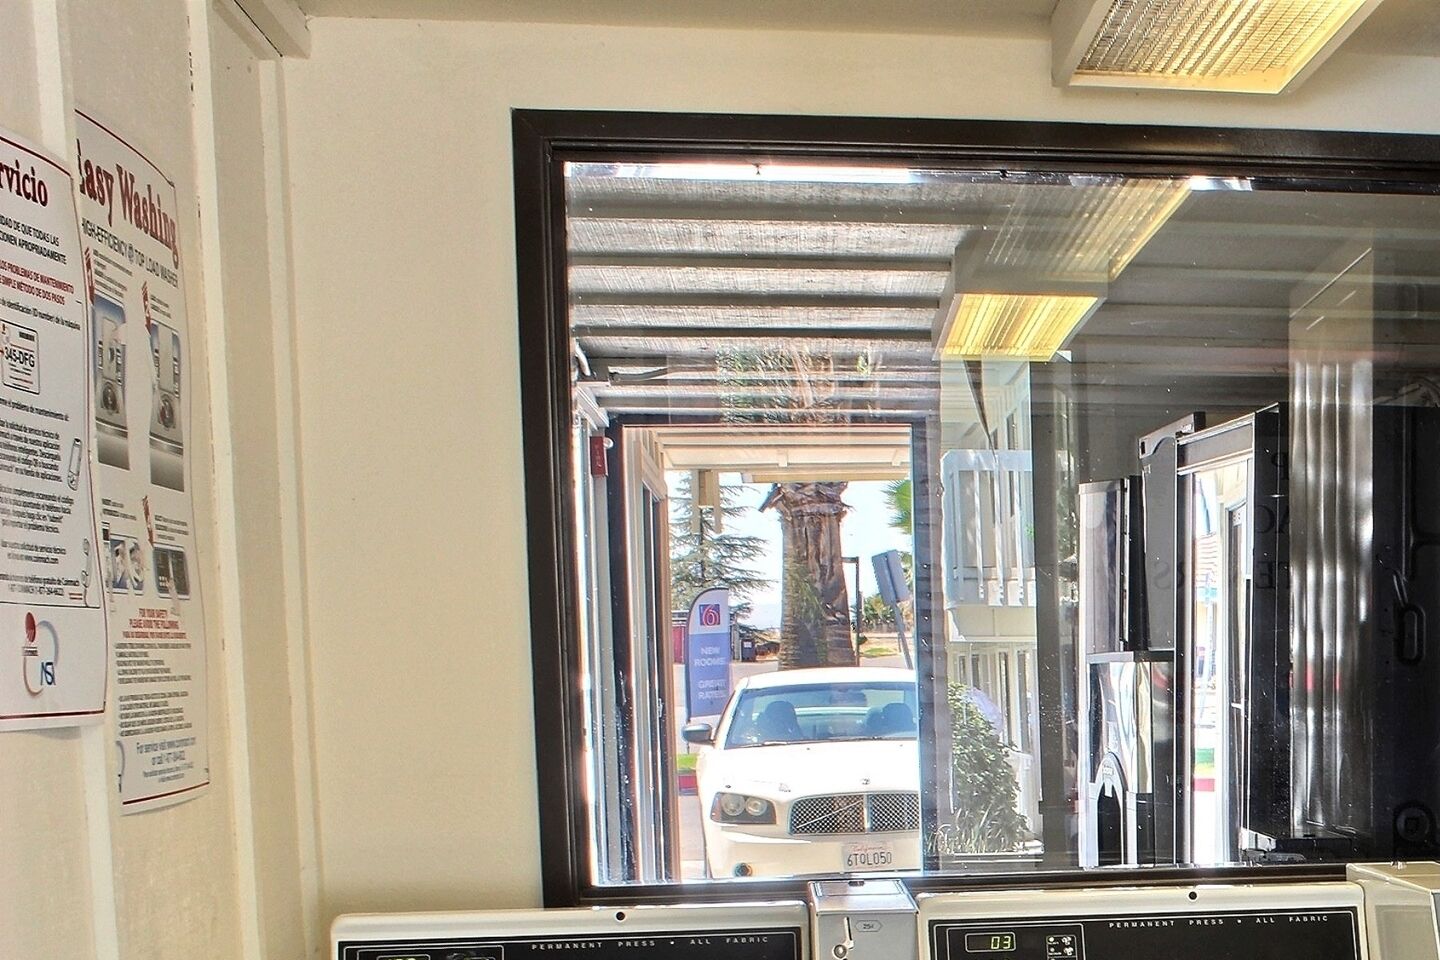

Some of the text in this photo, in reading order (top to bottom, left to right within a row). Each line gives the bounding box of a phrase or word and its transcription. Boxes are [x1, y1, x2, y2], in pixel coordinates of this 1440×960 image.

[116, 163, 179, 269] Washing
[700, 646, 720, 655] NEW
[1109, 920, 1175, 928] PERMANENT
[1289, 915, 1328, 923] FABRIC
[532, 942, 603, 950] PERMANENT
[726, 936, 768, 944] FABRIC
[990, 935, 1011, 950] 03
